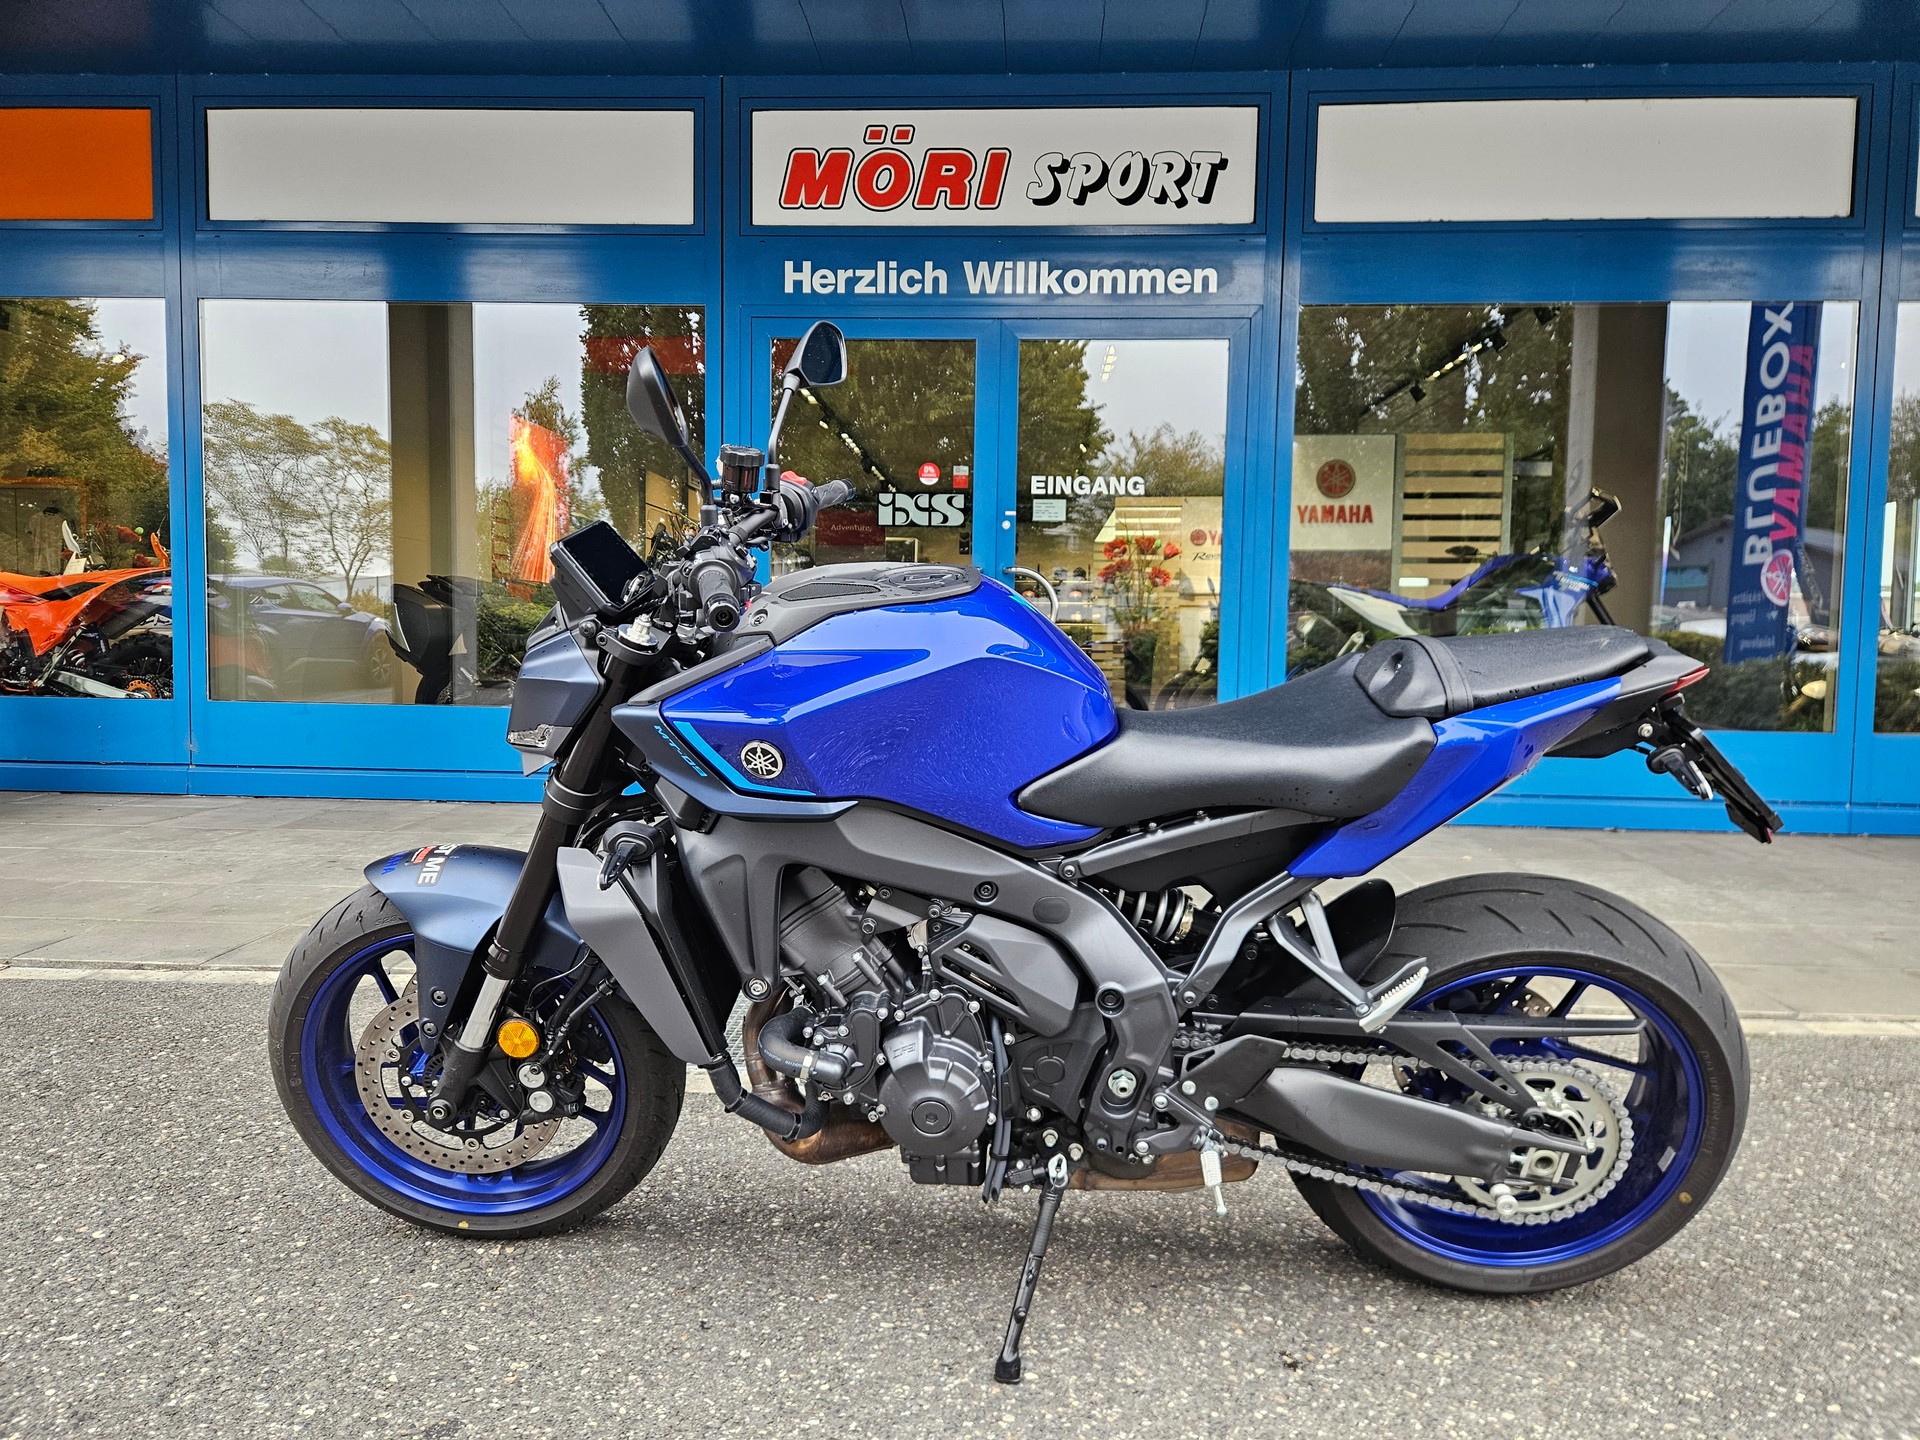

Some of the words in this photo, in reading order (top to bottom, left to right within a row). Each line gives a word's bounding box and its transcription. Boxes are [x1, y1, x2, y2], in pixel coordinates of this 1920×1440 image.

[779, 124, 1012, 211] MÖRI
[1025, 150, 1229, 208] SPORT
[784, 259, 948, 295] Herzlich
[963, 259, 1218, 295] Willkommen
[1769, 344, 1814, 541] YAMAHA
[1030, 475, 1146, 496] EINGANG
[1297, 503, 1374, 524] YAMAHA
[653, 725, 708, 777] MT-09
[417, 857, 446, 885] ME
